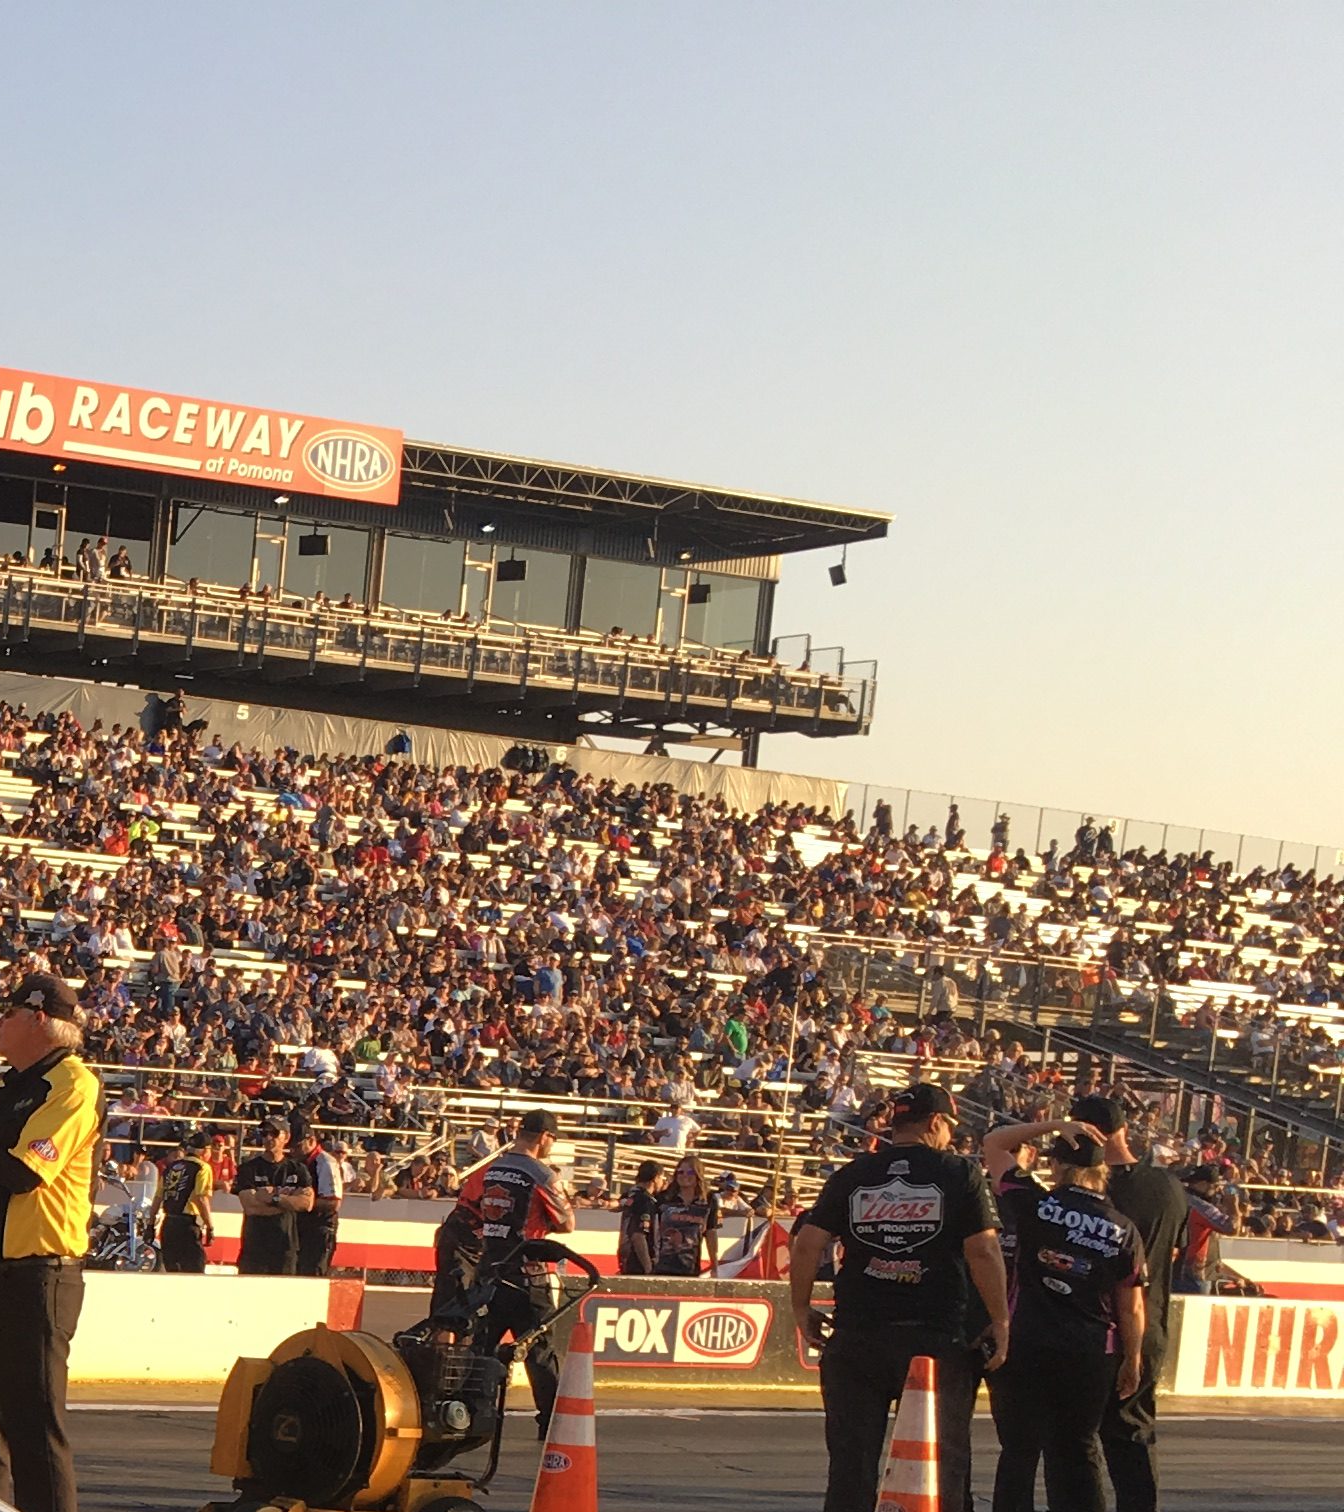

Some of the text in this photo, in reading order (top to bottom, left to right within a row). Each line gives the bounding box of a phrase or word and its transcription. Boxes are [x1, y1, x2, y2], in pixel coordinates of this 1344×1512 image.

[68, 385, 305, 459] RACEWAY
[205, 455, 294, 484] at Pomona
[318, 439, 383, 481] NHRA
[236, 704, 249, 720] 5
[555, 746, 568, 761] 6
[861, 1199, 936, 1221] LUCAS
[1037, 1203, 1127, 1245] CLONTZ
[856, 1223, 936, 1234] OIL PRODUCTS
[1066, 1229, 1120, 1258] Racing
[594, 1306, 749, 1354] FOX NHRA
[1203, 1303, 1344, 1390] NHR
